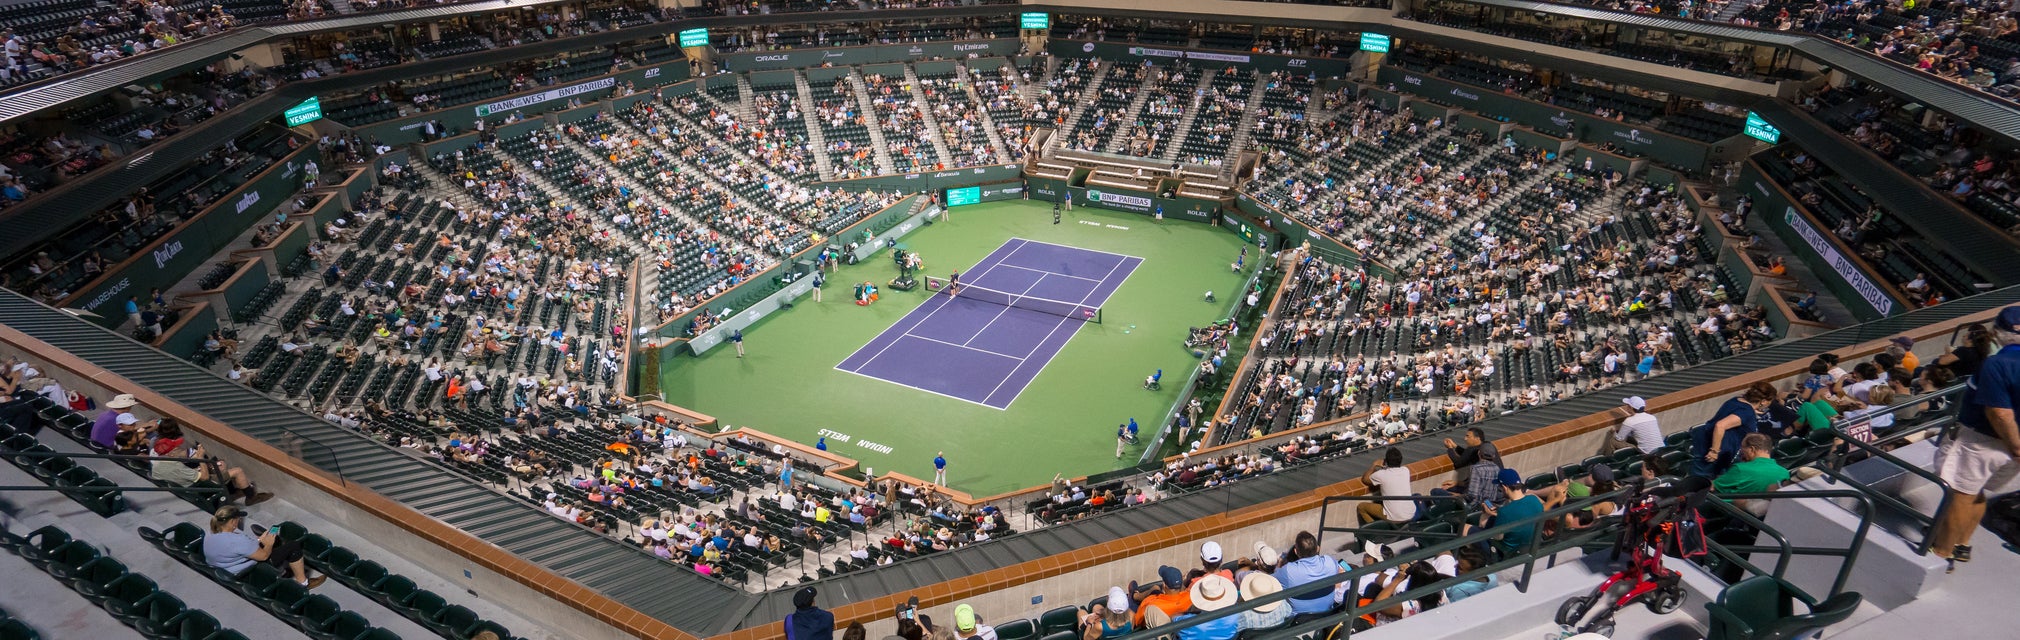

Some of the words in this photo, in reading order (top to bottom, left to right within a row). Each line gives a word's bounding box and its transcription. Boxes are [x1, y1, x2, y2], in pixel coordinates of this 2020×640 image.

[645, 68, 660, 77] ATP
[1404, 74, 1421, 86] Hertz
[490, 101, 516, 112] BANK
[522, 94, 546, 105] WEST
[559, 87, 576, 97] BNP
[578, 79, 613, 94] PARIBAS
[290, 111, 320, 124] VESNINA
[1748, 126, 1776, 142] VESNINA
[1119, 196, 1148, 206] PARIBAS
[1792, 215, 1808, 237] BANK
[1811, 232, 1829, 256] WEST
[1835, 257, 1852, 280] BNP
[1852, 272, 1888, 314] PARIBAS
[87, 278, 130, 310] WAREHOUSE
[817, 428, 851, 443] WELLS
[1850, 424, 1869, 434] SECTION
[857, 440, 893, 454] INDIAN
